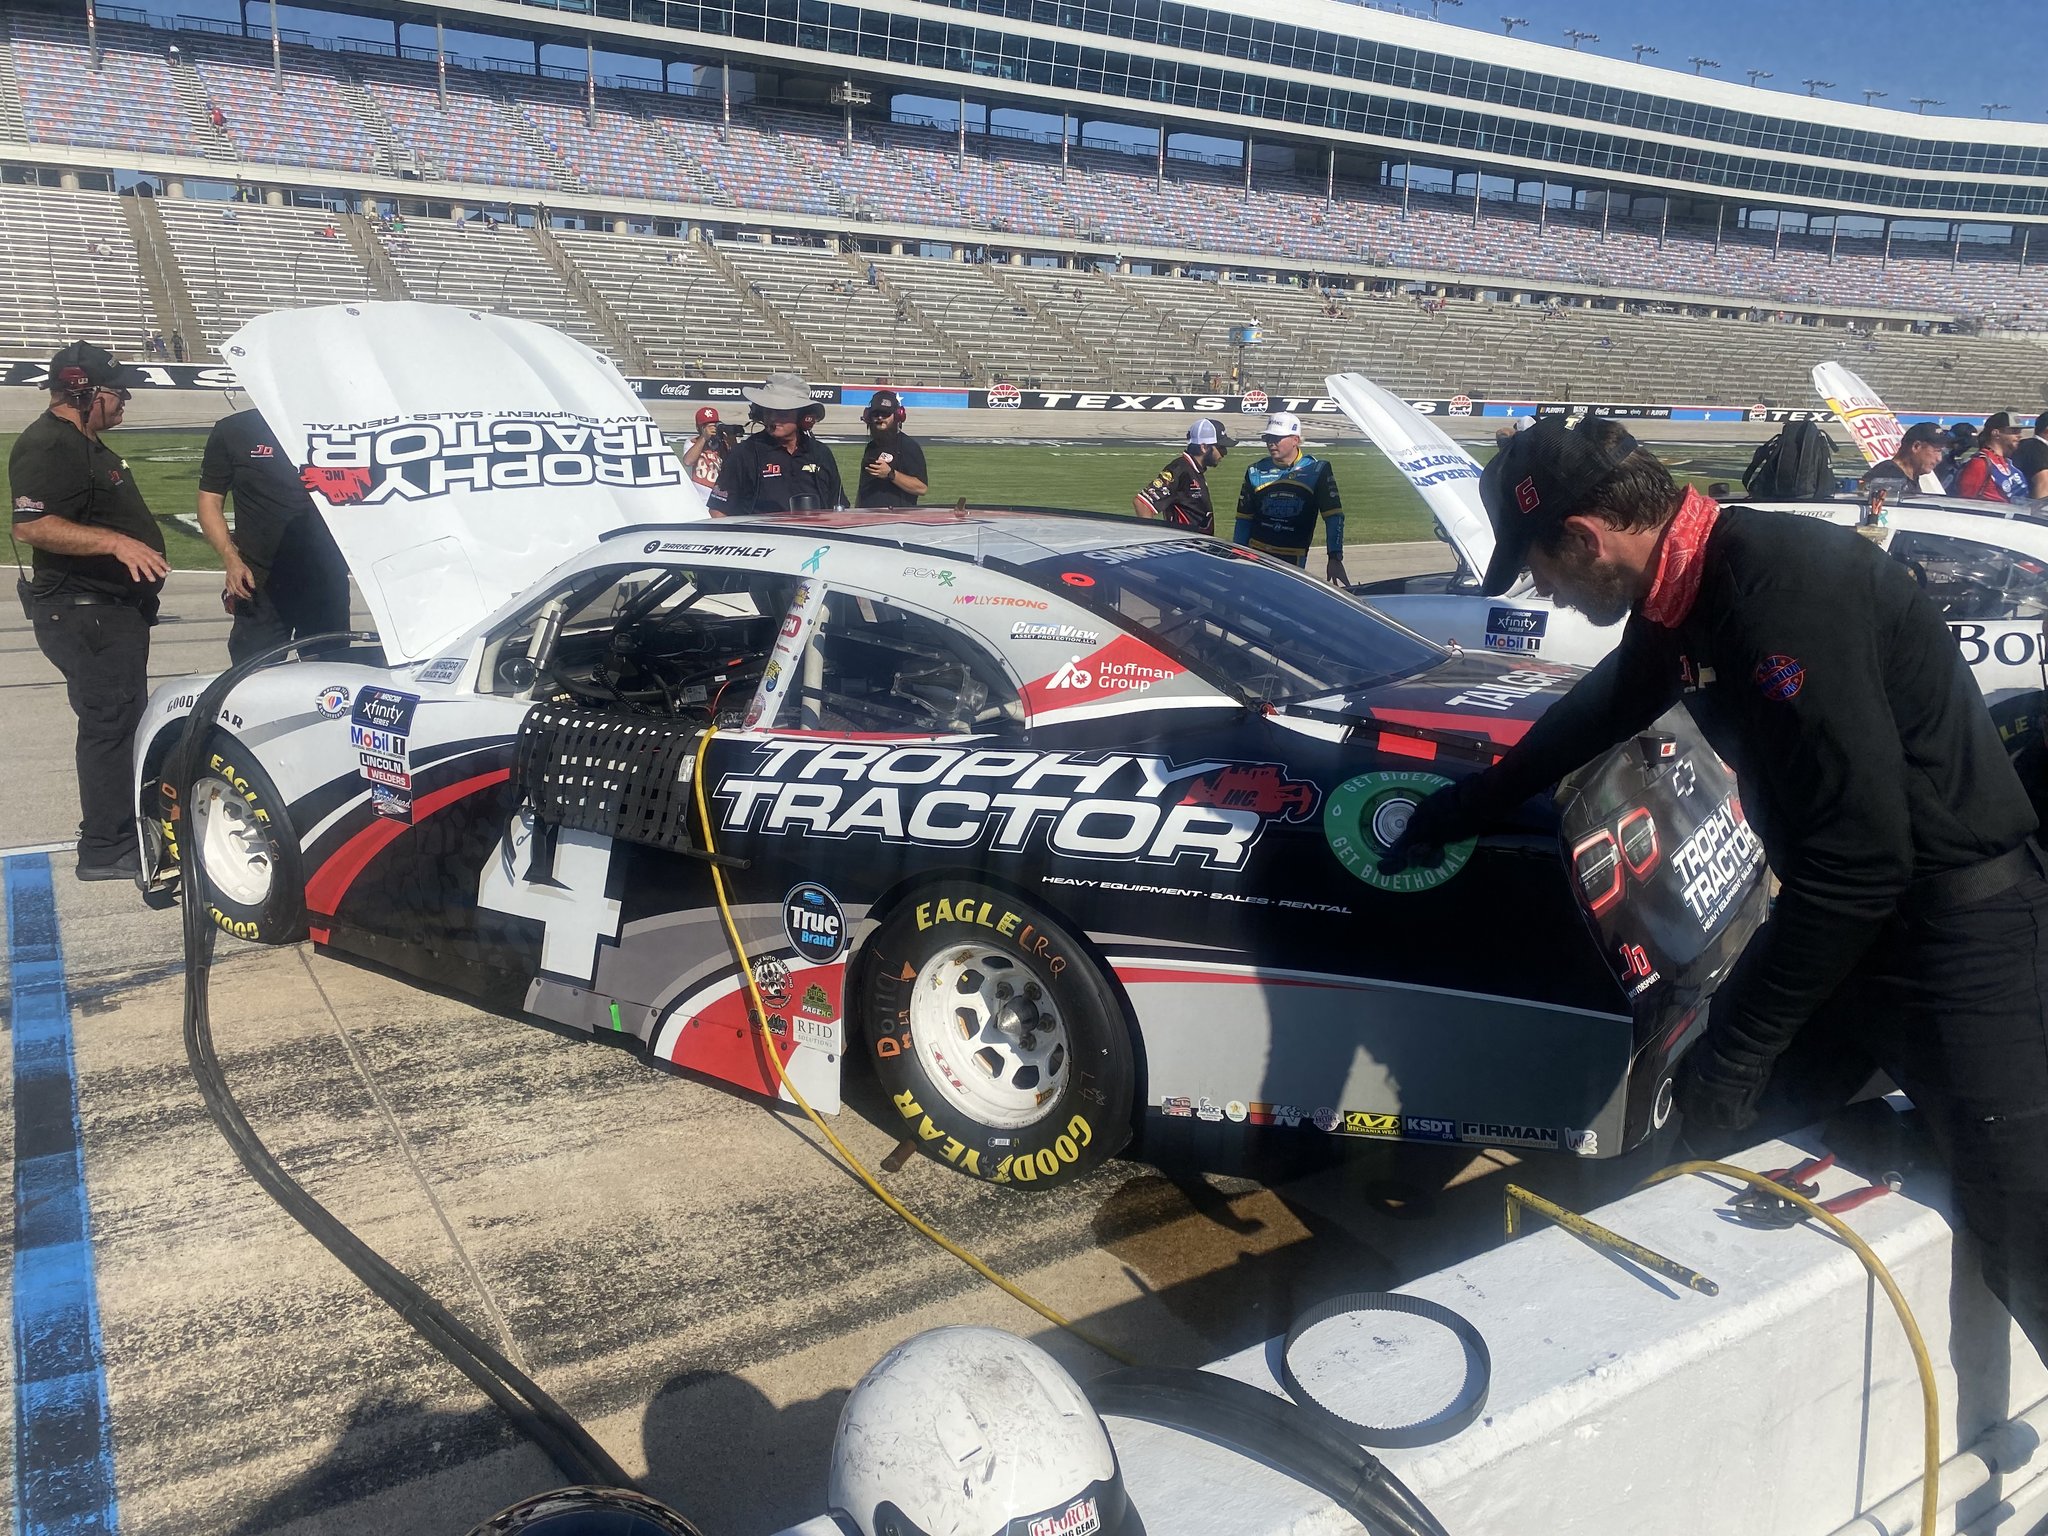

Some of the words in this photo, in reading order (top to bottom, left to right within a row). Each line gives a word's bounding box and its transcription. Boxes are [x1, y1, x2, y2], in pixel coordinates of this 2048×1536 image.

[708, 387, 741, 396] GEICO
[1038, 393, 1227, 411] TEXAS
[302, 414, 400, 431] RENTAL
[413, 410, 484, 421] SALES
[498, 410, 599, 424] EQUIPMENT
[308, 421, 675, 469] TRACTOR
[695, 457, 719, 483] 88
[1398, 455, 1467, 472] ROOFING
[321, 469, 347, 482] INC.
[361, 453, 681, 503] TROPHY
[1515, 475, 1540, 513] 6
[660, 543, 703, 551] BARRETT
[700, 545, 776, 558] SMITHLEY
[1497, 615, 1537, 631] xfinity
[1485, 634, 1523, 648] Mobil
[438, 671, 453, 680] CAR
[1100, 662, 1175, 680] Hoffman
[1099, 675, 1150, 692] Group
[380, 692, 402, 702] NASCAR
[363, 700, 404, 724] xfinity
[372, 718, 389, 727] SERIES
[351, 726, 389, 751] Mobil
[361, 754, 402, 773] LINCOLN
[752, 741, 1232, 798] TROPHY
[371, 768, 406, 786] WELDERS
[1343, 775, 1373, 793] GET
[210, 754, 272, 824] EAGLE
[1221, 787, 1259, 808] INC.
[721, 779, 1261, 868] TRACTOR
[1672, 797, 1739, 884] TROPHY
[1332, 836, 1360, 866] GET
[1684, 820, 1758, 918] TRACTOR
[477, 814, 622, 981] 4
[1042, 876, 1099, 888] HEAVY
[1099, 881, 1203, 898] EQUIPMENT
[1210, 892, 1269, 905] SALES
[1278, 899, 1352, 914] RENTAL
[790, 906, 839, 935] True
[916, 898, 1023, 938] EAGLE
[1702, 908, 1721, 933] HEAVY
[801, 931, 836, 948] Brand
[1628, 971, 1661, 999] MOTORSPORTS
[798, 1019, 833, 1039] RFID
[798, 1034, 833, 1048] SOLUTIONS
[1347, 1124, 1381, 1134] MECHANIX
[1408, 1118, 1454, 1133] KSDT
[1463, 1122, 1558, 1142] FIRMAN
[1463, 1136, 1497, 1144] POWER
[1499, 1138, 1558, 1148] EQUIPMENT
[1033, 1500, 1094, 1536] G-FORCE
[1075, 1519, 1095, 1535] GEAR
